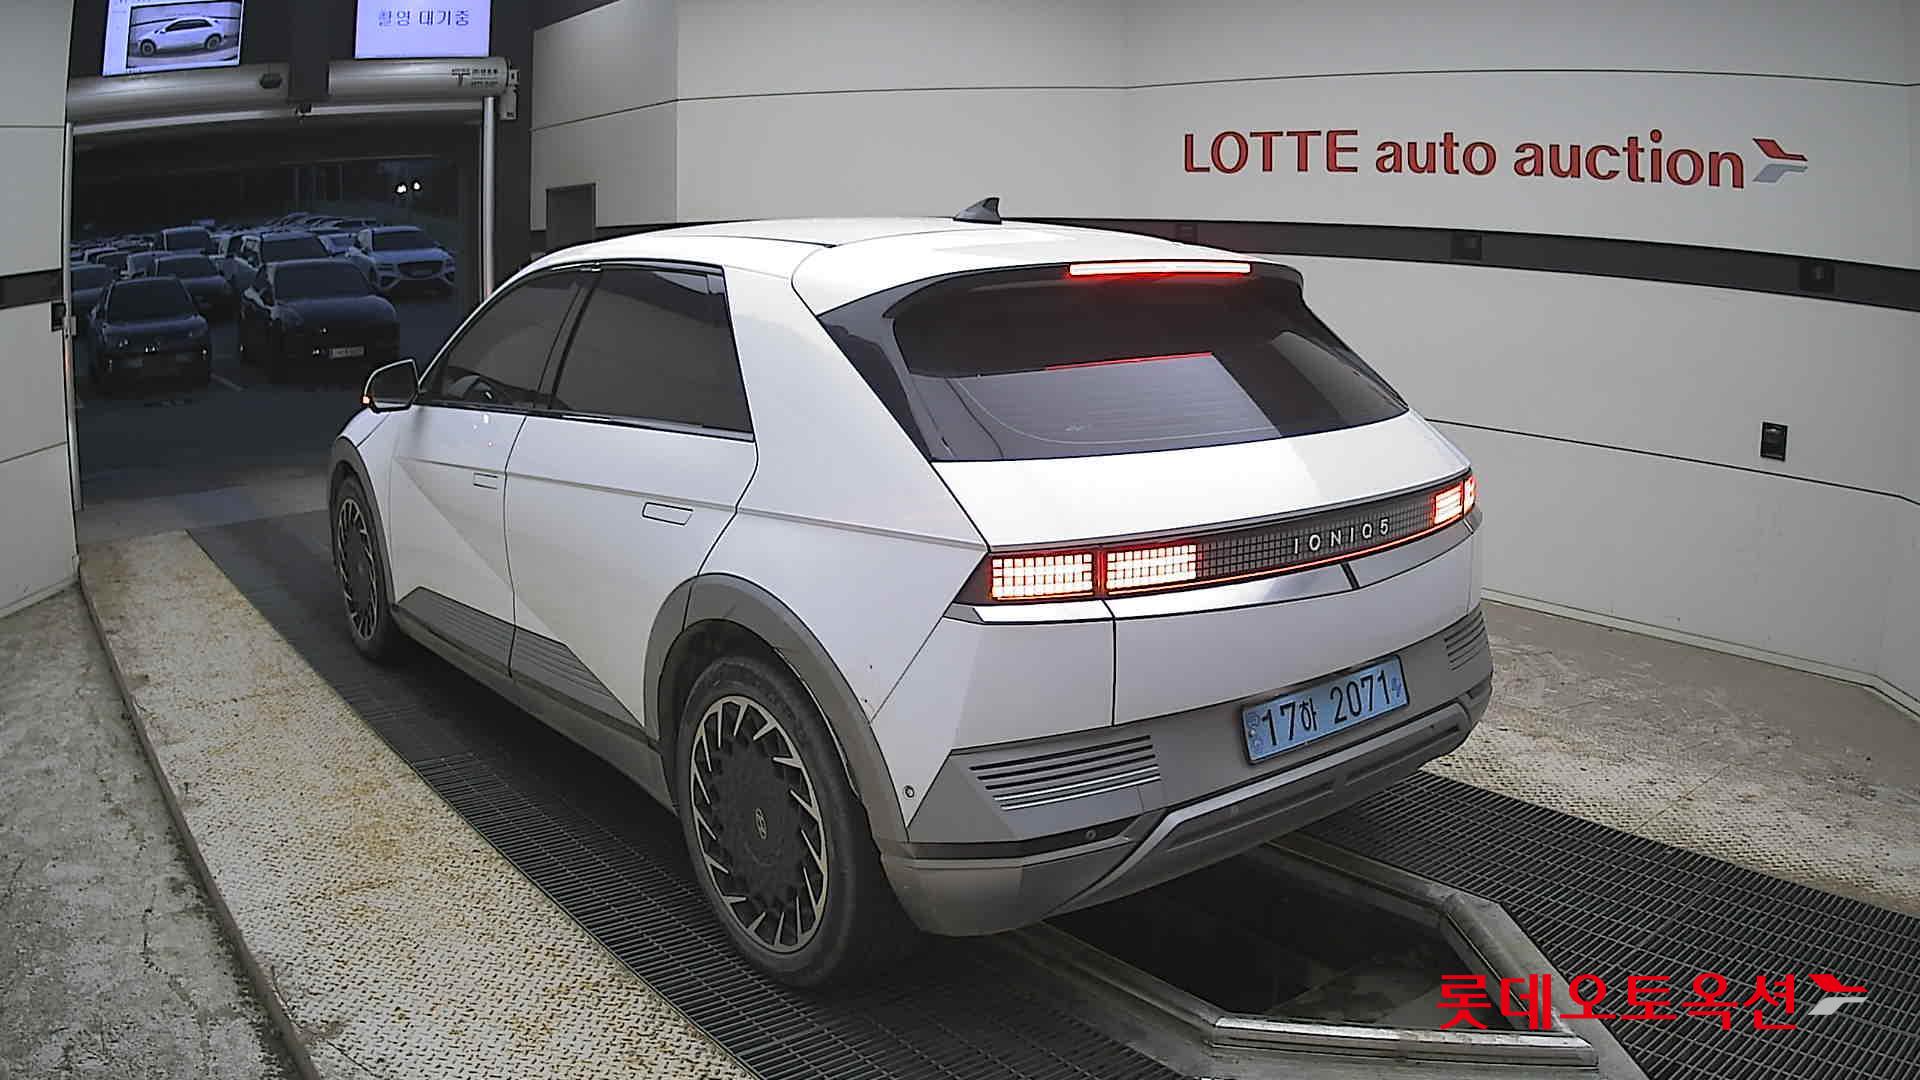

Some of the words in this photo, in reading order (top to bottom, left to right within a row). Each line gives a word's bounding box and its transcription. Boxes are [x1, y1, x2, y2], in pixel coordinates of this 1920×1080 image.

[419, 9, 470, 26] 대기중
[1184, 129, 1358, 173] LOTTE
[1375, 131, 1497, 176] auto
[1513, 129, 1745, 189] auction
[1261, 697, 1318, 747] 17하
[1329, 669, 1391, 725] 2071
